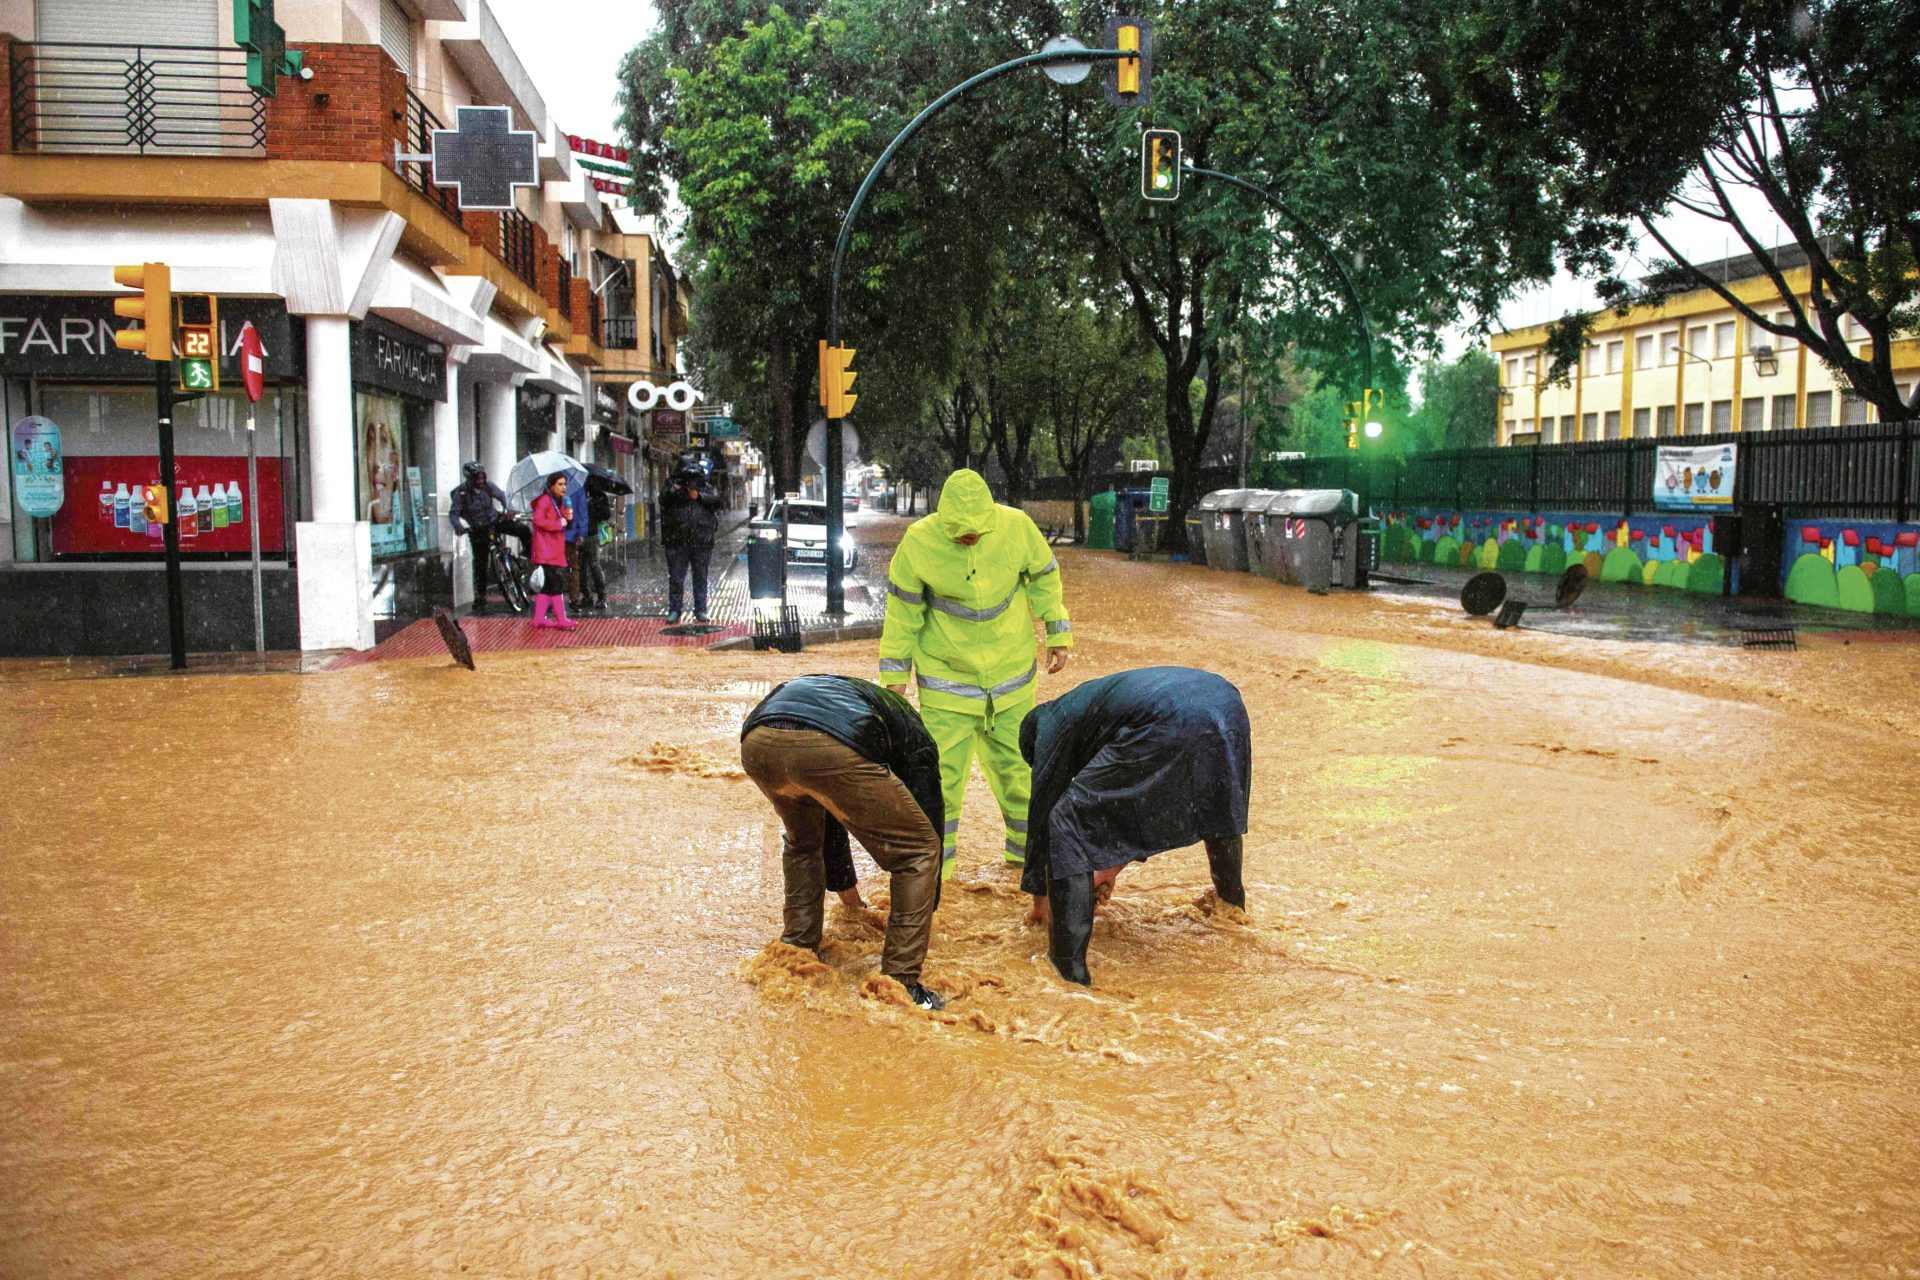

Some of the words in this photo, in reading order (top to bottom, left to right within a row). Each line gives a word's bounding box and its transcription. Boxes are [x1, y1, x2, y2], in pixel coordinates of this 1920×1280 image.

[0, 318, 268, 356] FARMIA
[187, 333, 209, 354] 22
[378, 335, 438, 385] FARMACIA
